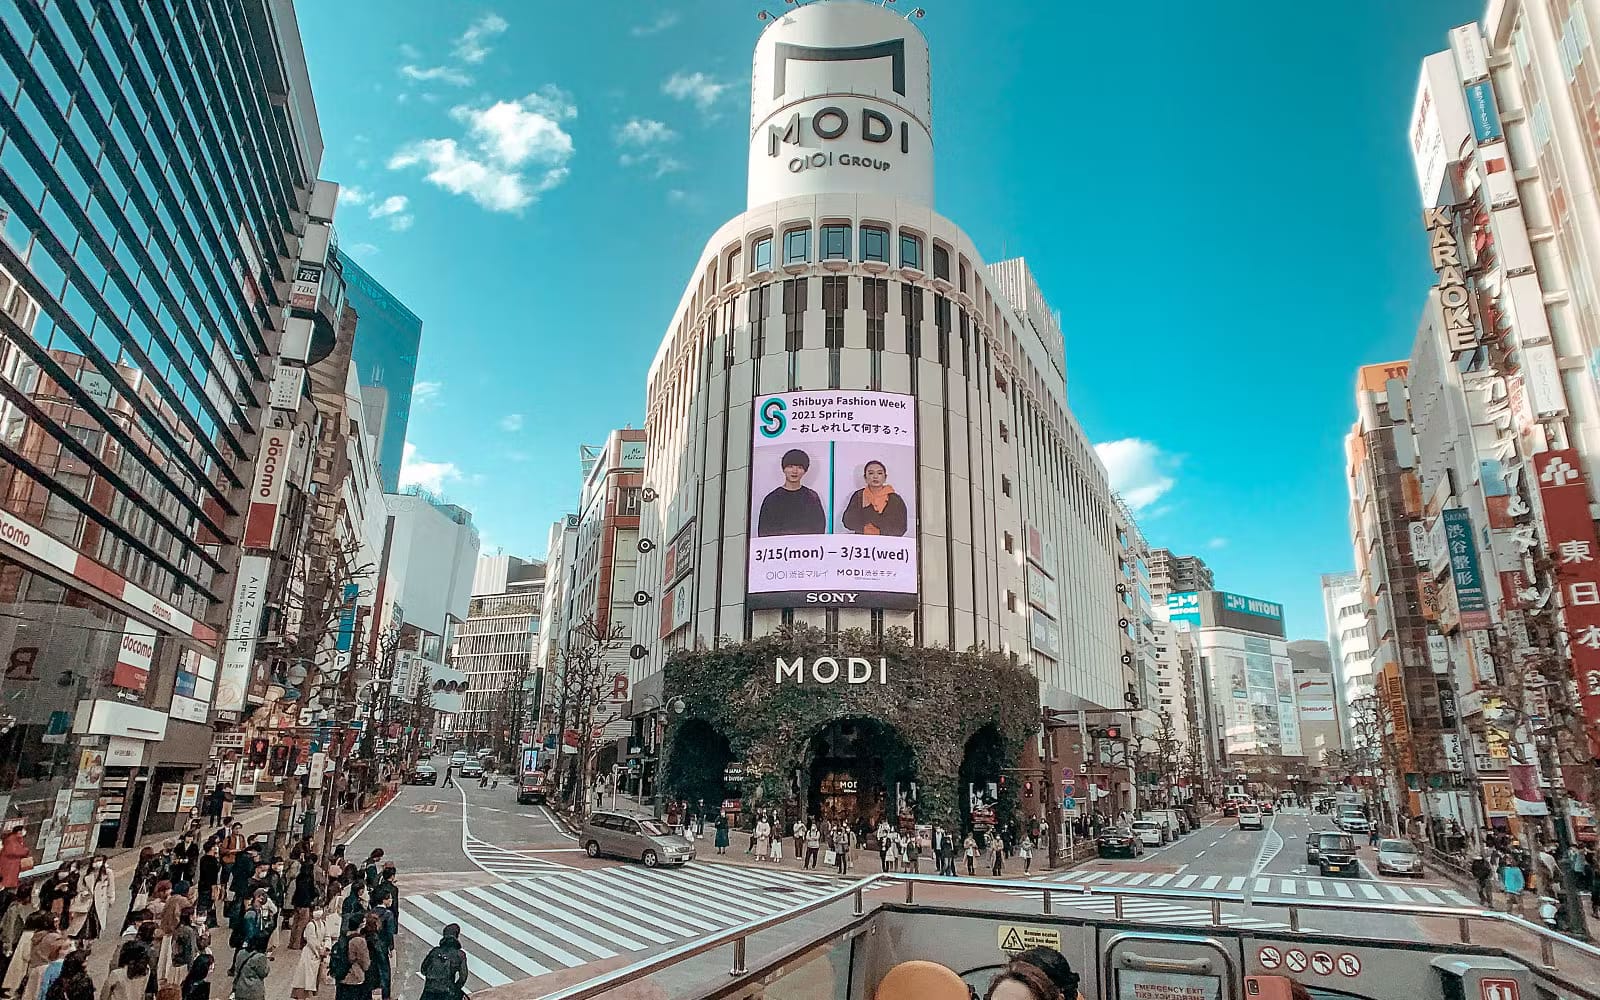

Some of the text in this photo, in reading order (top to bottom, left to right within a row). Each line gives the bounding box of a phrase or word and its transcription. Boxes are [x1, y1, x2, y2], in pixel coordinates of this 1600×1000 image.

[768, 106, 909, 158] MODI
[838, 154, 891, 171] GROUP
[1424, 206, 1478, 352] KARAOKE
[792, 396, 906, 410] Shibuya Fashion Week
[792, 410, 854, 421] 2021 Spring
[261, 437, 283, 497] docomo
[0, 520, 30, 546] como
[755, 545, 824, 563] 3/15(mon)
[840, 546, 909, 563] 3/31(wed)
[1447, 524, 1474, 586] 渋谷整形
[245, 576, 259, 608] AINZ
[806, 592, 859, 603] SONY
[1169, 594, 1198, 607] ニトリ
[1227, 594, 1280, 617] ニトリ NITORI
[122, 635, 152, 659] docomo
[775, 656, 888, 685] MODI
[613, 675, 629, 700] R
[298, 707, 313, 726] 5
[1080, 763, 1087, 773] 5
[1134, 983, 1204, 995] EMERGENCY EXIT
